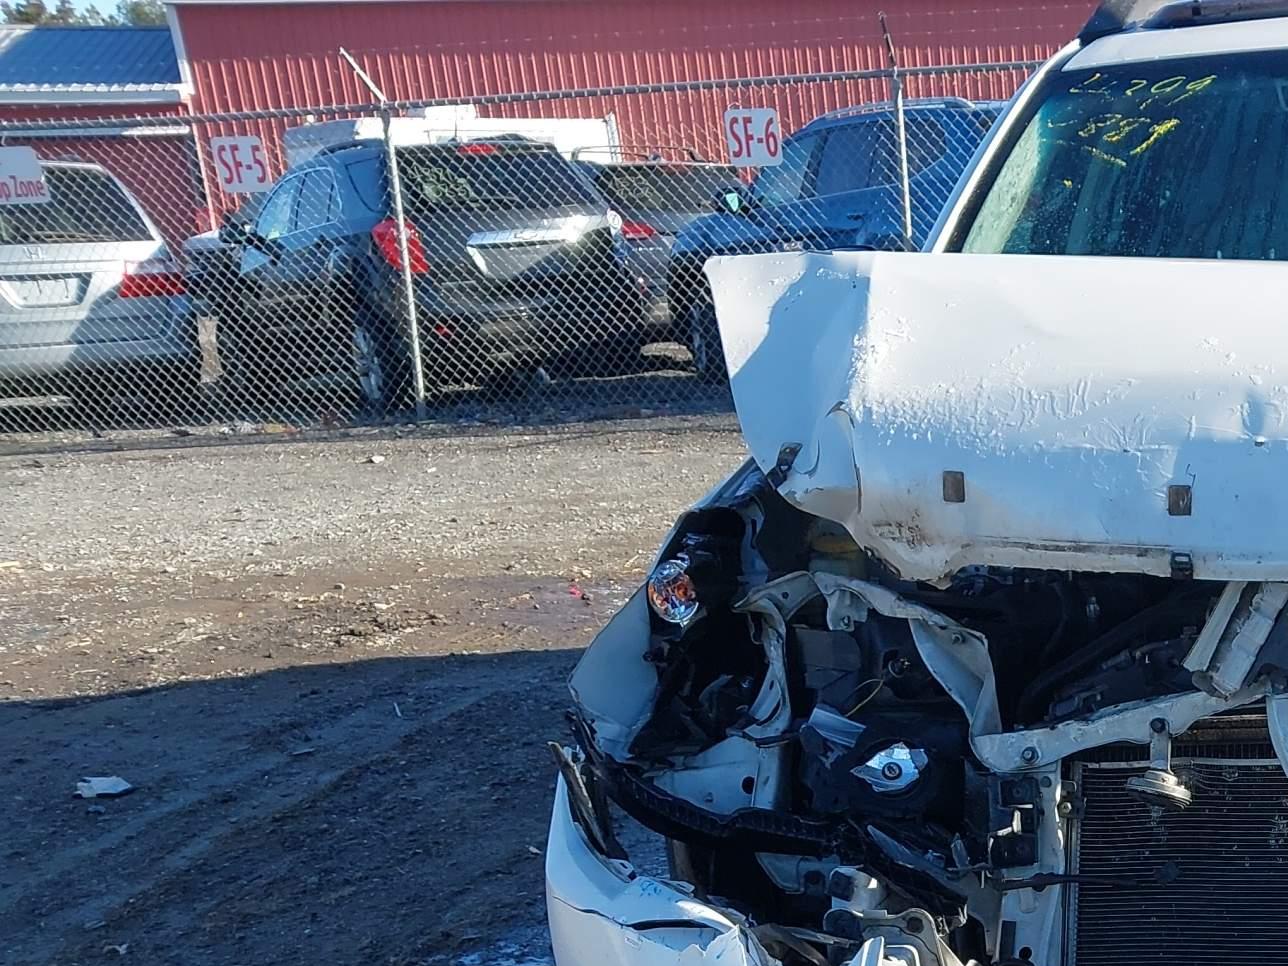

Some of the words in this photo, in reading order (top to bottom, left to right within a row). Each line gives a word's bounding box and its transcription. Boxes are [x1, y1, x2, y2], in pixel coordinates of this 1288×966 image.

[729, 116, 778, 158] SF-6
[217, 143, 267, 185] SF-5
[8, 175, 46, 199] Zone
